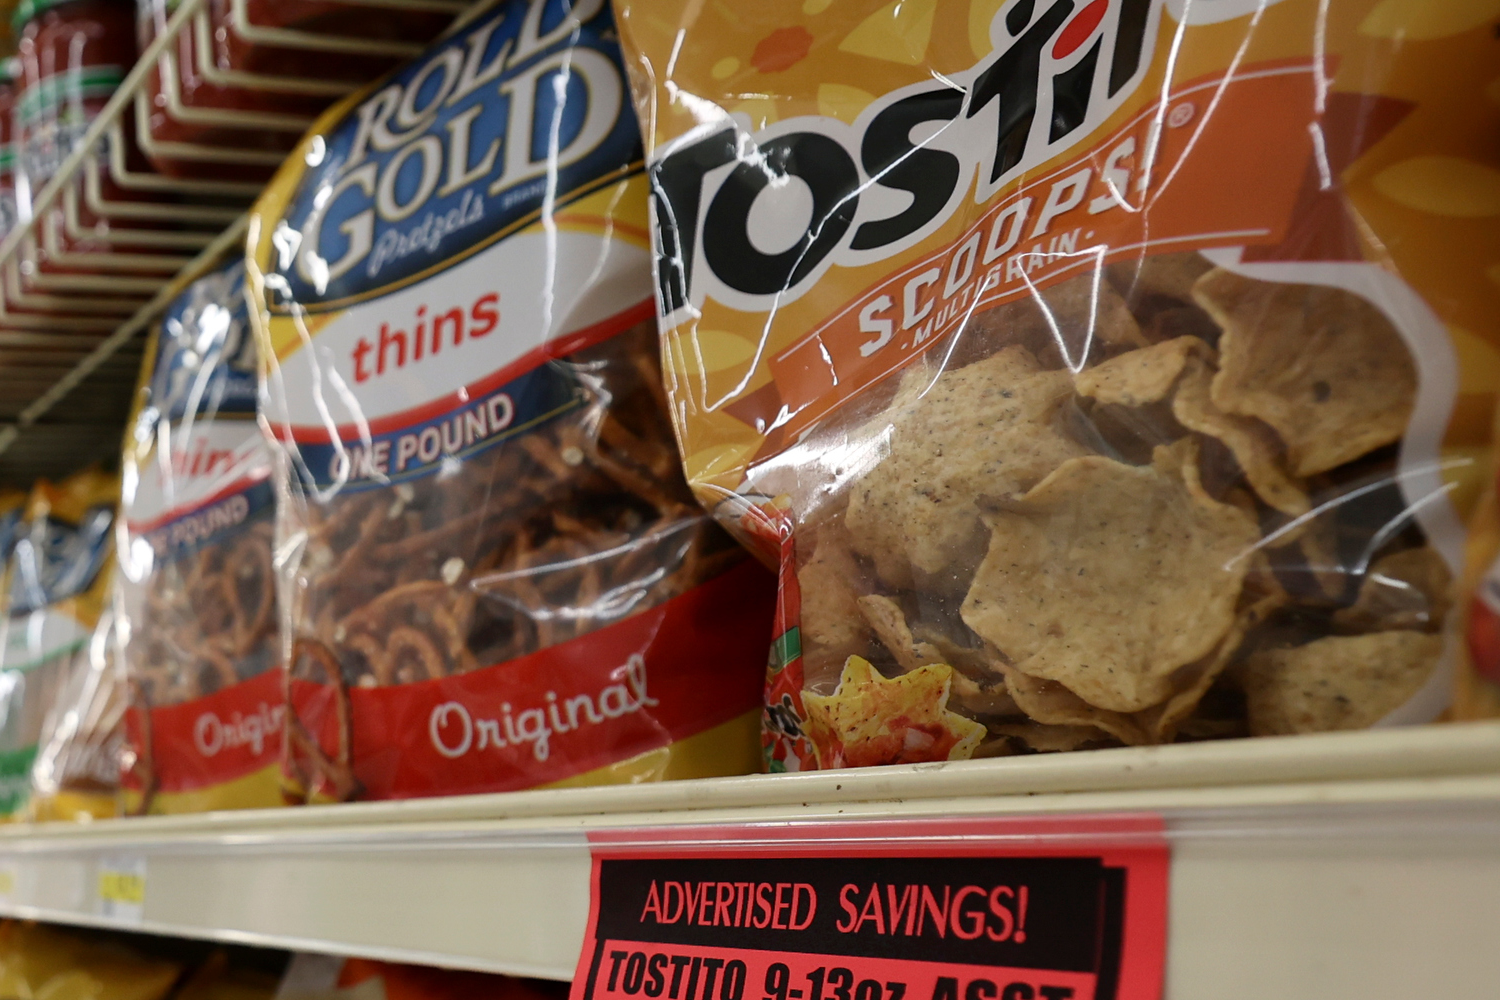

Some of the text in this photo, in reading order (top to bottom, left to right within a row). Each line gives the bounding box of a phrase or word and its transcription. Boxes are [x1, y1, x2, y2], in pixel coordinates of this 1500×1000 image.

[296, 47, 624, 286] GOLD
[366, 188, 485, 277] Pretzels
[859, 118, 1161, 358] SCOOPS!
[353, 292, 500, 383] thins
[329, 392, 516, 481] ONE POUND
[194, 700, 288, 758] Origin
[429, 653, 659, 762] Original
[640, 878, 1028, 944] ADVERTISED SAVINGS!
